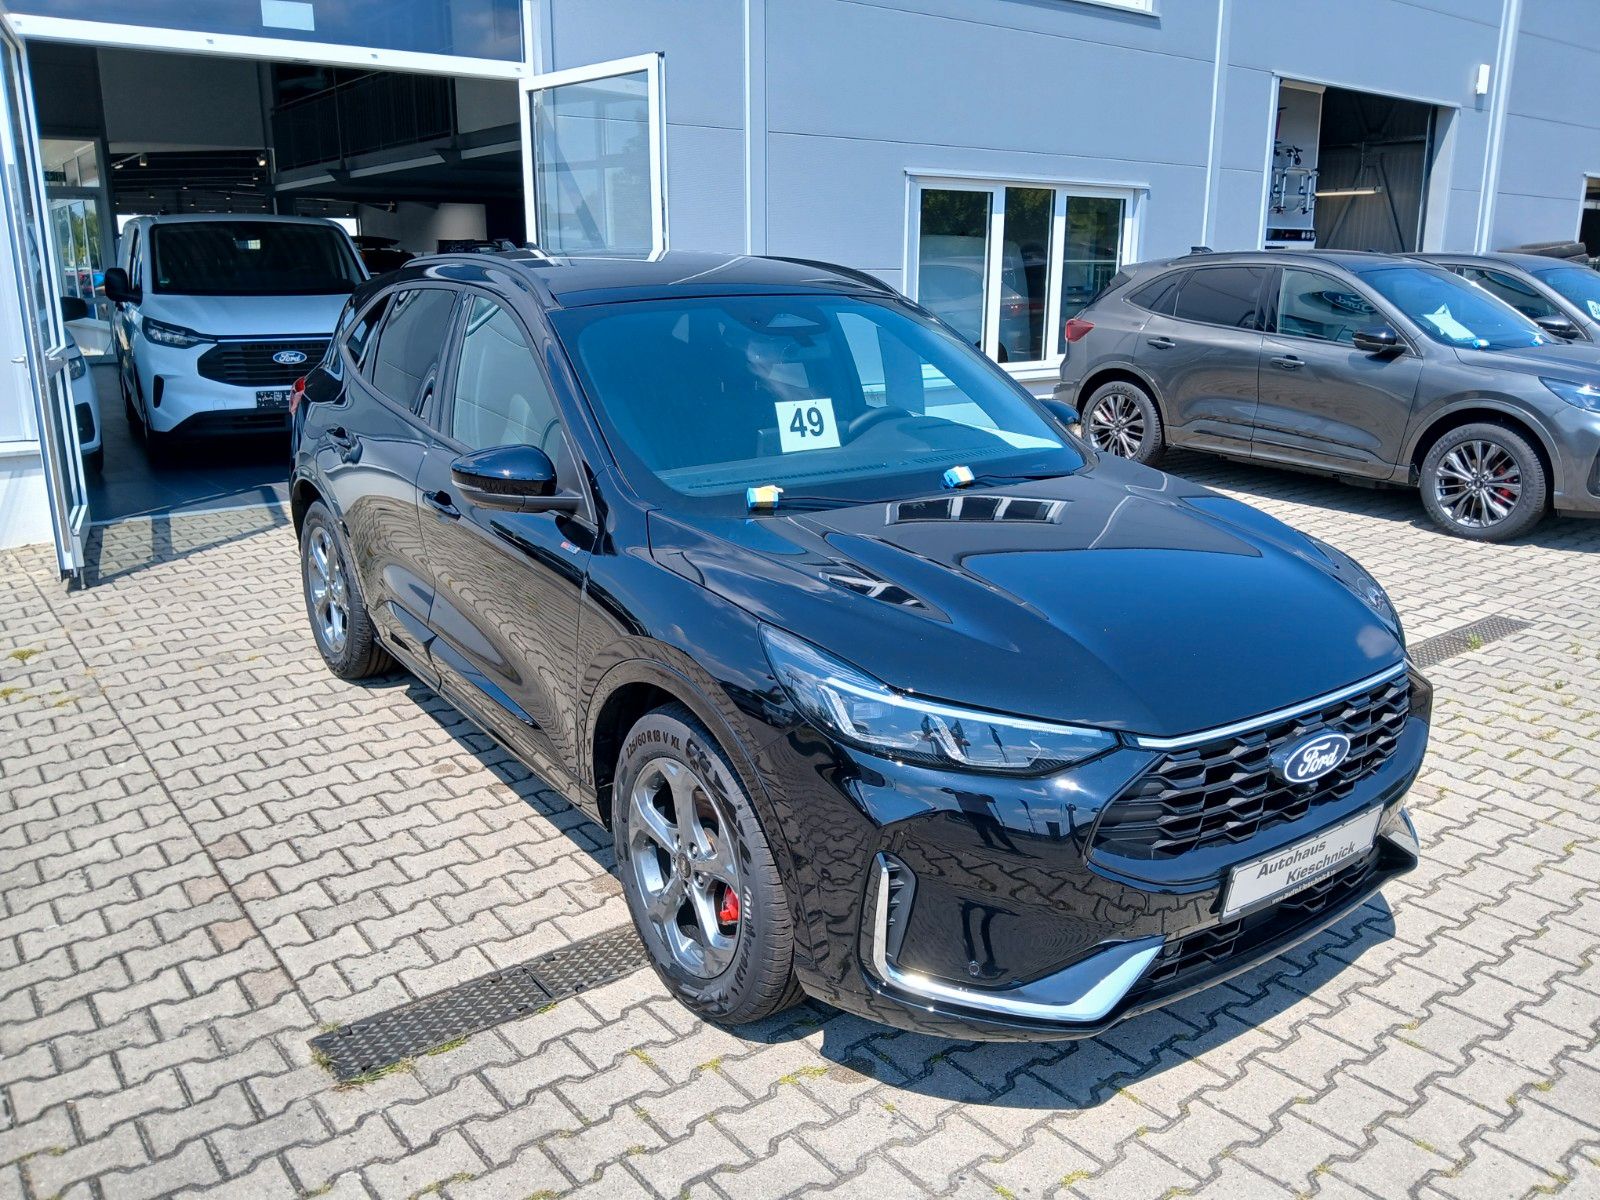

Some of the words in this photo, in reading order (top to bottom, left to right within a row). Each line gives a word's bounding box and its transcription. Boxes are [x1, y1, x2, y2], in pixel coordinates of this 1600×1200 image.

[790, 407, 824, 437] 49
[1297, 742, 1340, 777] Ford
[1256, 841, 1327, 879] Autohaus
[1286, 841, 1355, 885] Kieschnick
